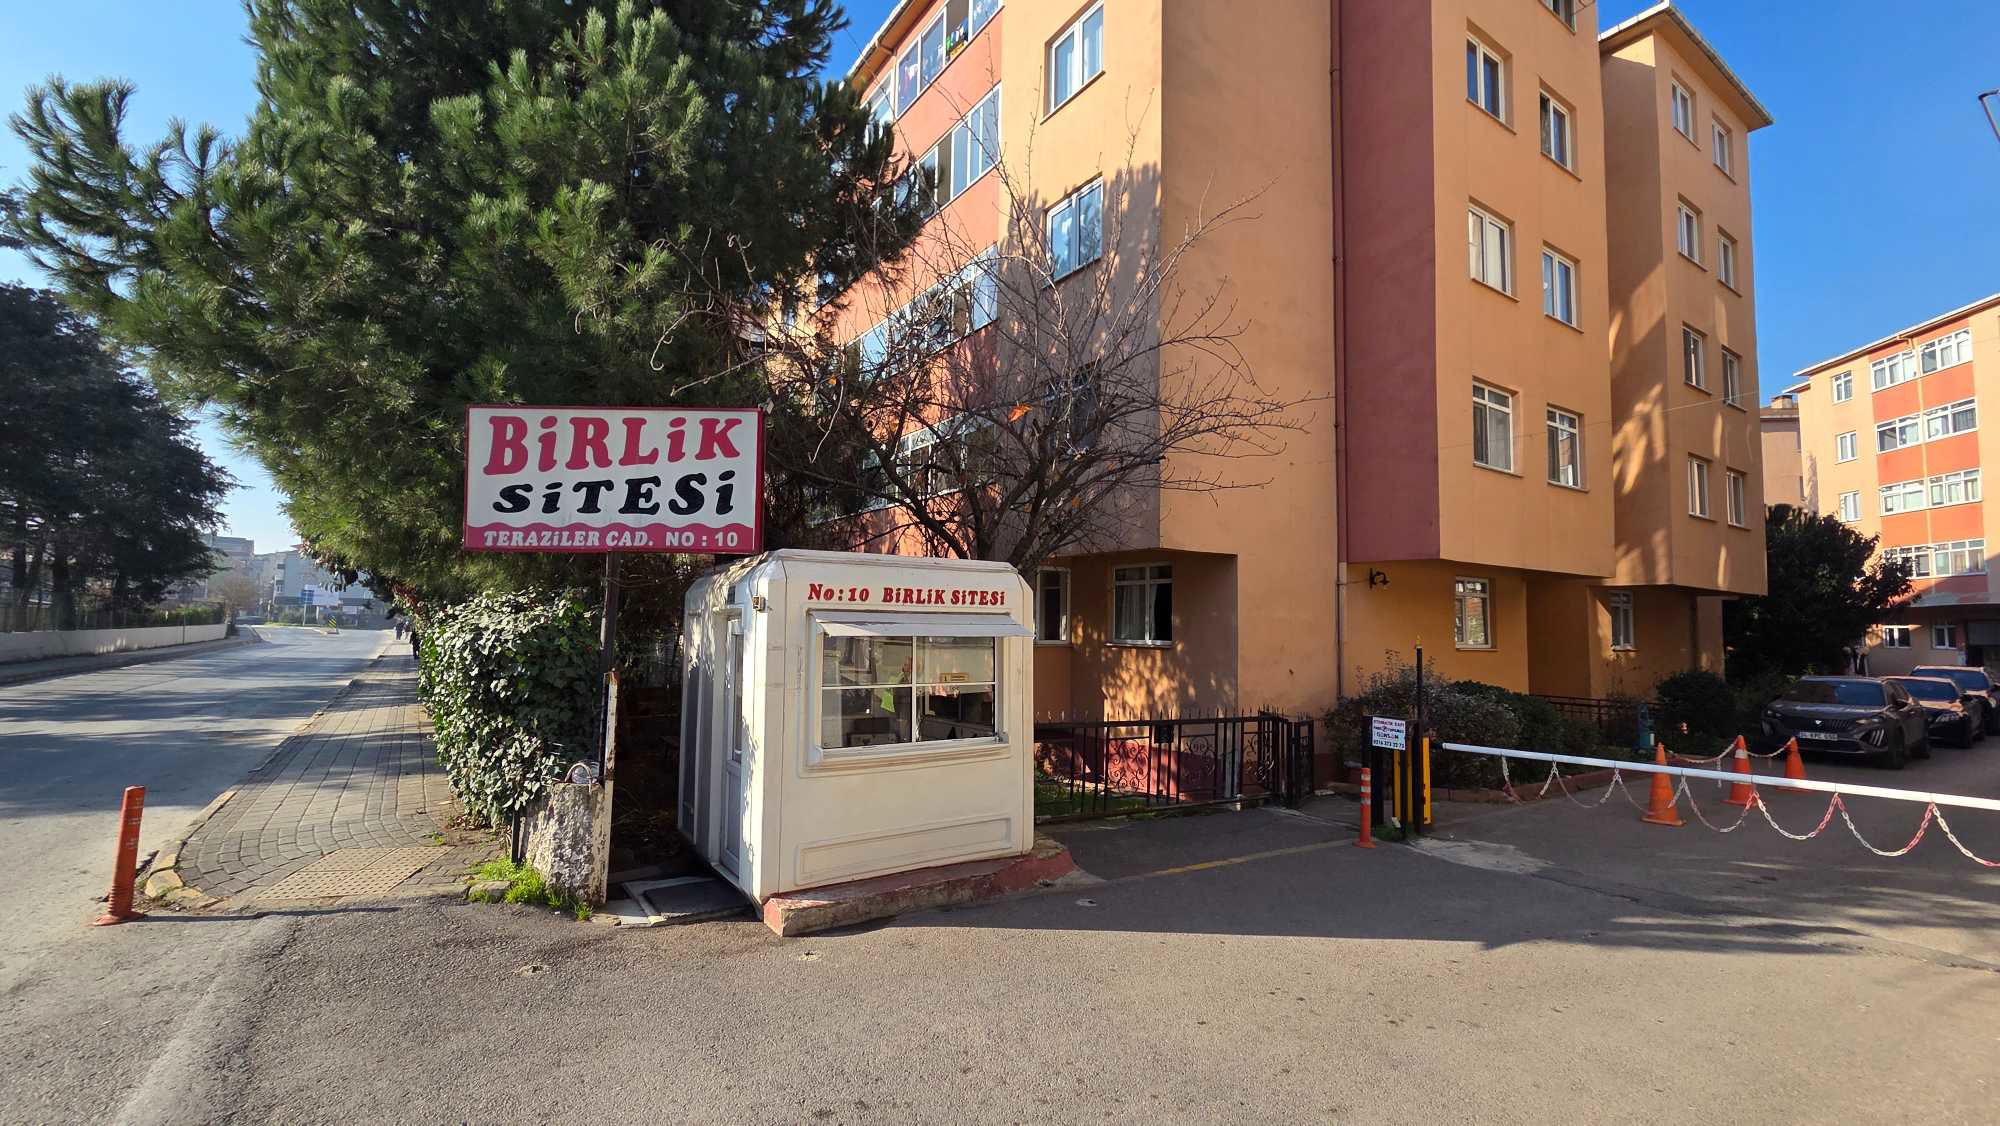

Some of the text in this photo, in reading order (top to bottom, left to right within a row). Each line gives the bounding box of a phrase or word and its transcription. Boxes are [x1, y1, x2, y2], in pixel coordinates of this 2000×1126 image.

[605, 531, 654, 547] CAD.
[665, 531, 695, 547] NO
[715, 531, 738, 547] 10
